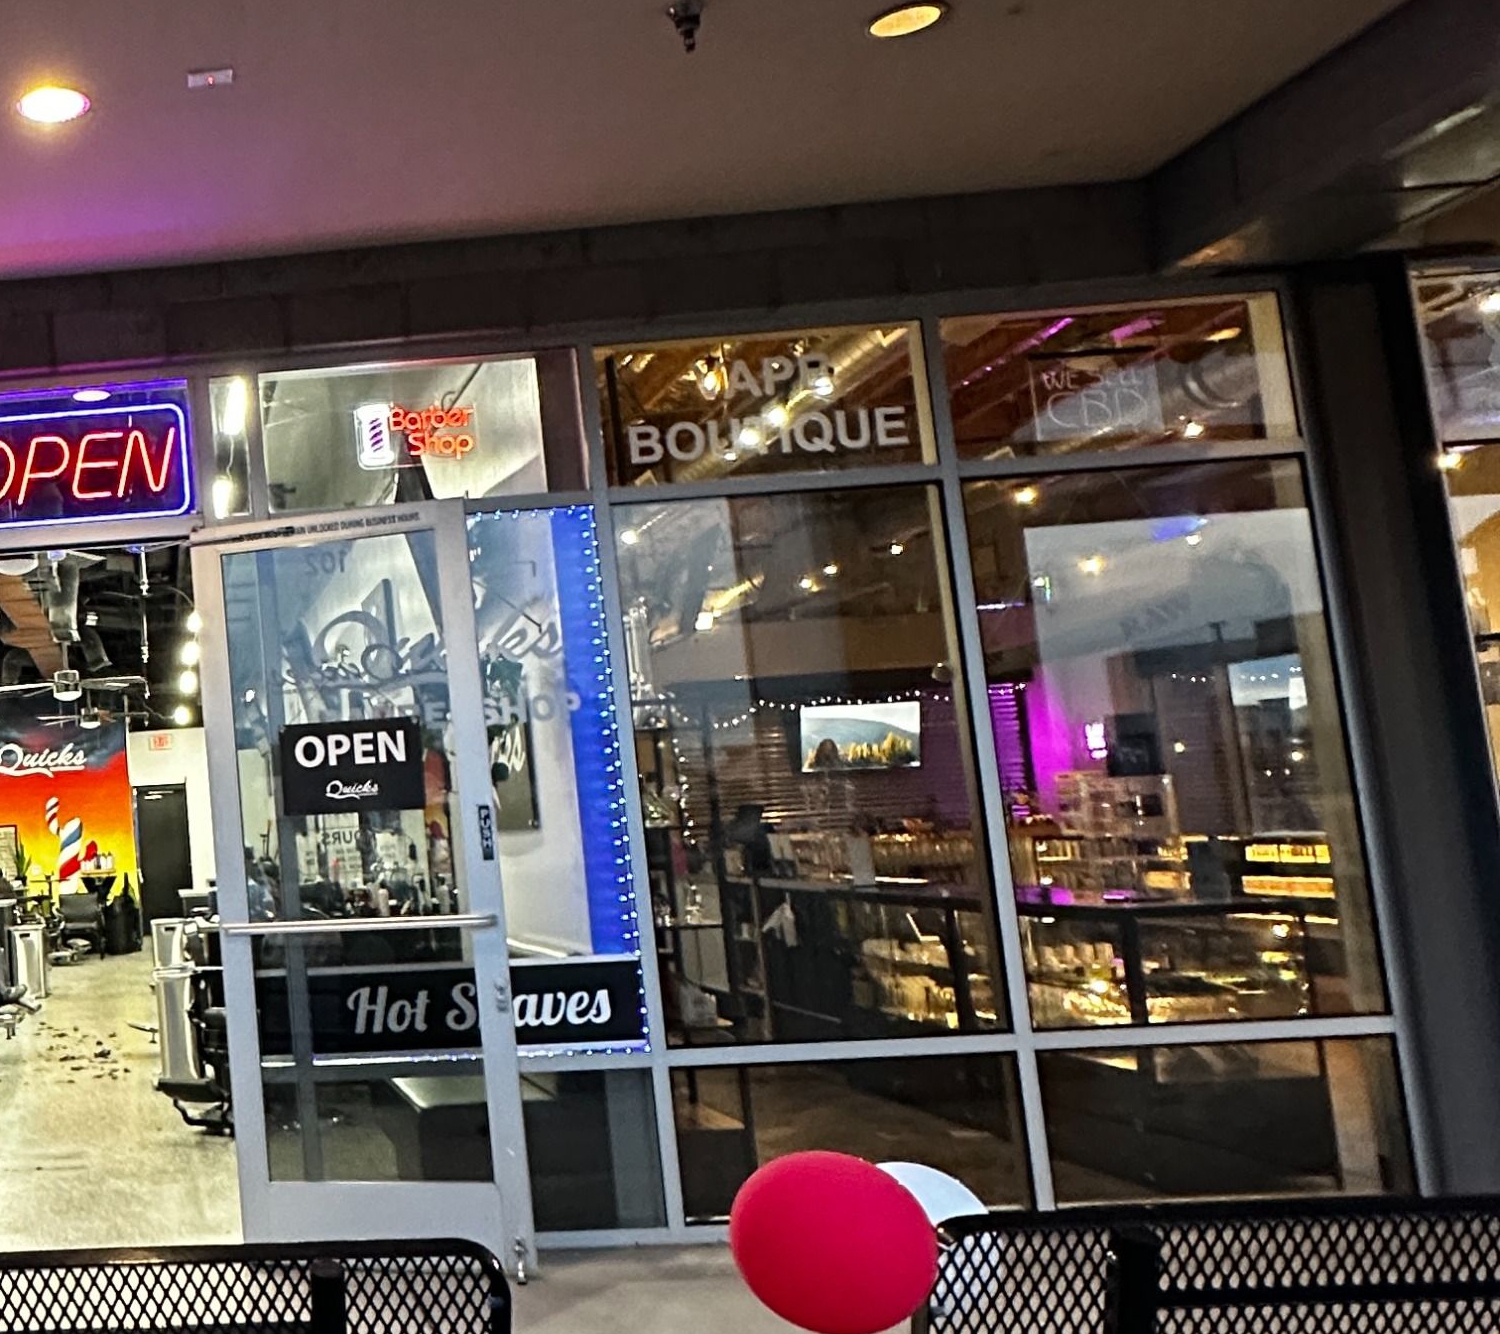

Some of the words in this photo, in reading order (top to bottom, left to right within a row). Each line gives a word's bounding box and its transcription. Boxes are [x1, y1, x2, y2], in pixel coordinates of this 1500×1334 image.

[389, 406, 474, 431] Barber
[1047, 388, 1149, 428] CBD
[408, 431, 474, 459] Shop
[294, 730, 406, 768] OPEN
[325, 779, 379, 800] Quicks
[479, 807, 494, 855] PUSH
[347, 986, 431, 1035] Hot
[446, 981, 612, 1031] Saves
